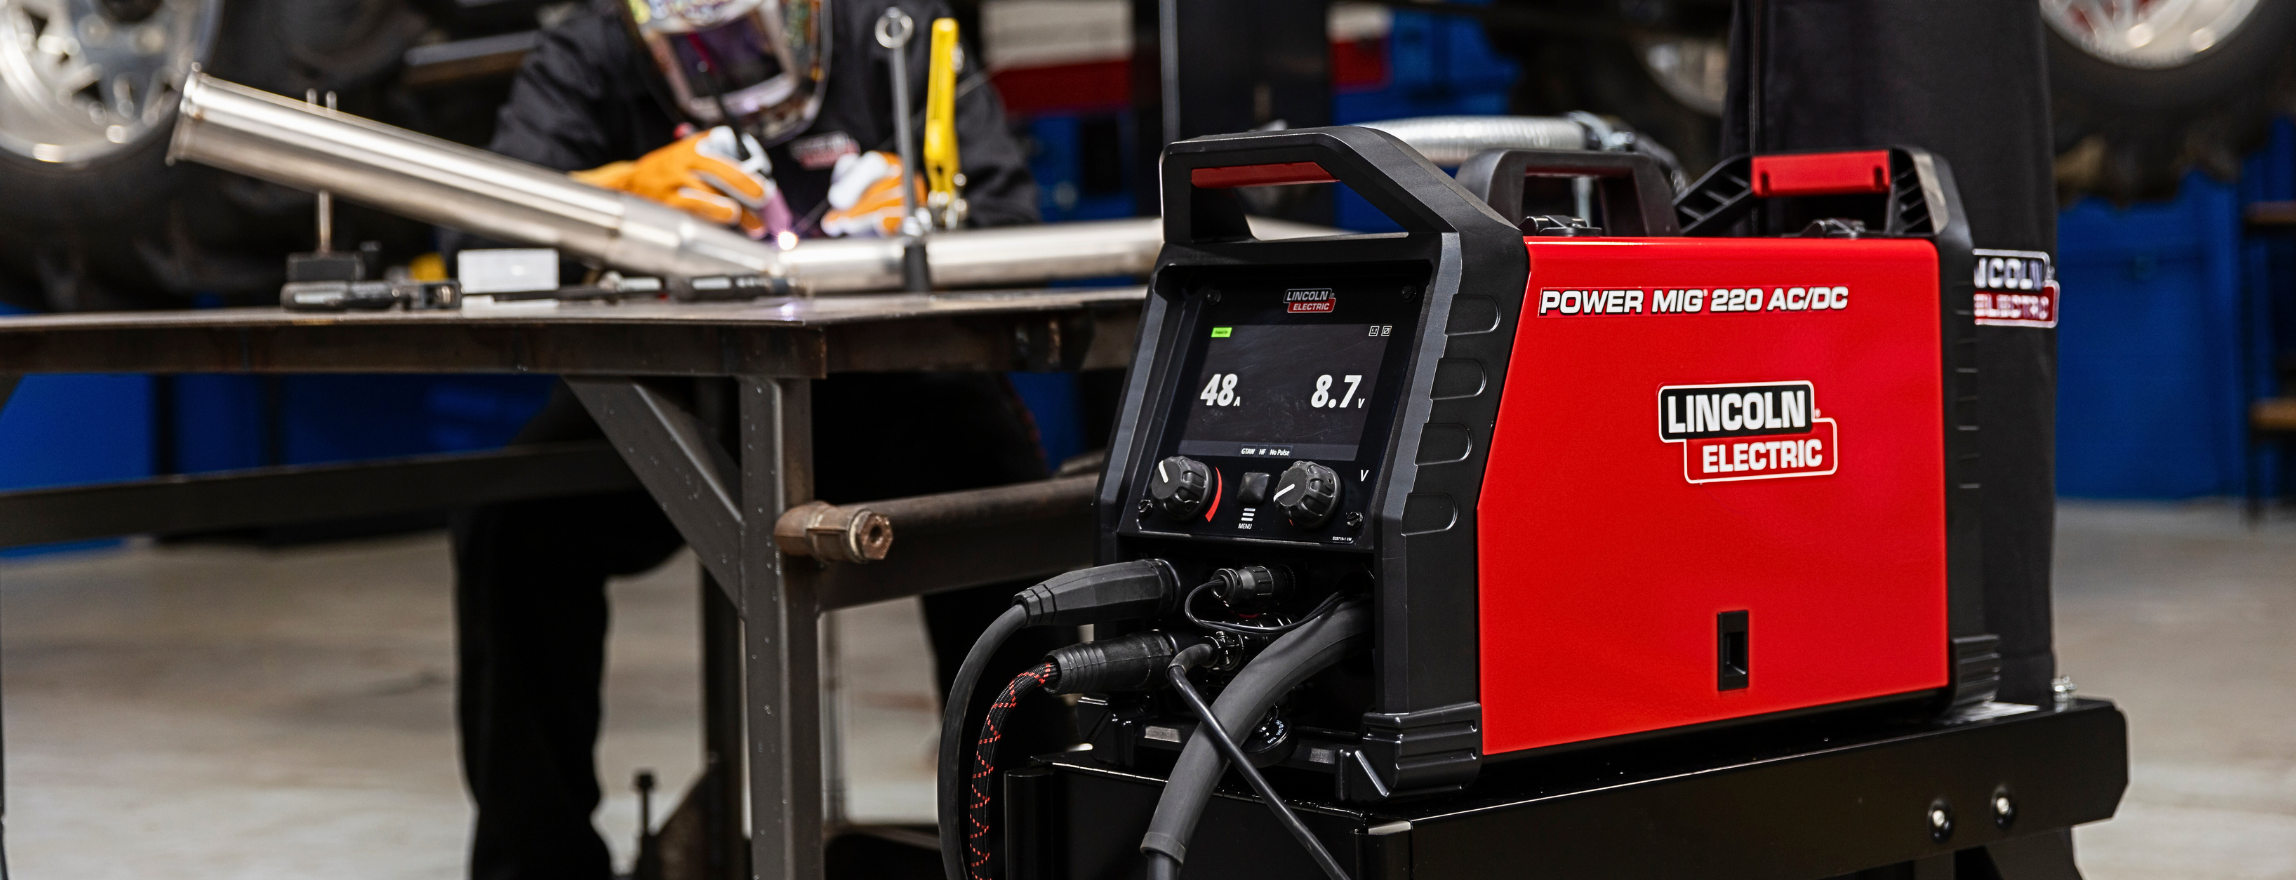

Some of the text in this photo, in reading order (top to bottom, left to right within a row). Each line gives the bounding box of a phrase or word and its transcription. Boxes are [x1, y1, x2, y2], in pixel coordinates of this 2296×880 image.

[1286, 290, 1329, 301] LINCOLN
[1293, 302, 1330, 311] ELECTRIC
[1539, 289, 1645, 316] POWER
[1709, 288, 1764, 313] 220
[1766, 286, 1849, 312] AC/DC
[1200, 373, 1239, 407] 48
[1311, 374, 1362, 409] 8.7
[1667, 390, 1806, 434] LINCOLN
[1702, 438, 1823, 474] ELECTRIC
[1360, 469, 1370, 482] V
[1237, 522, 1253, 530] MENU
